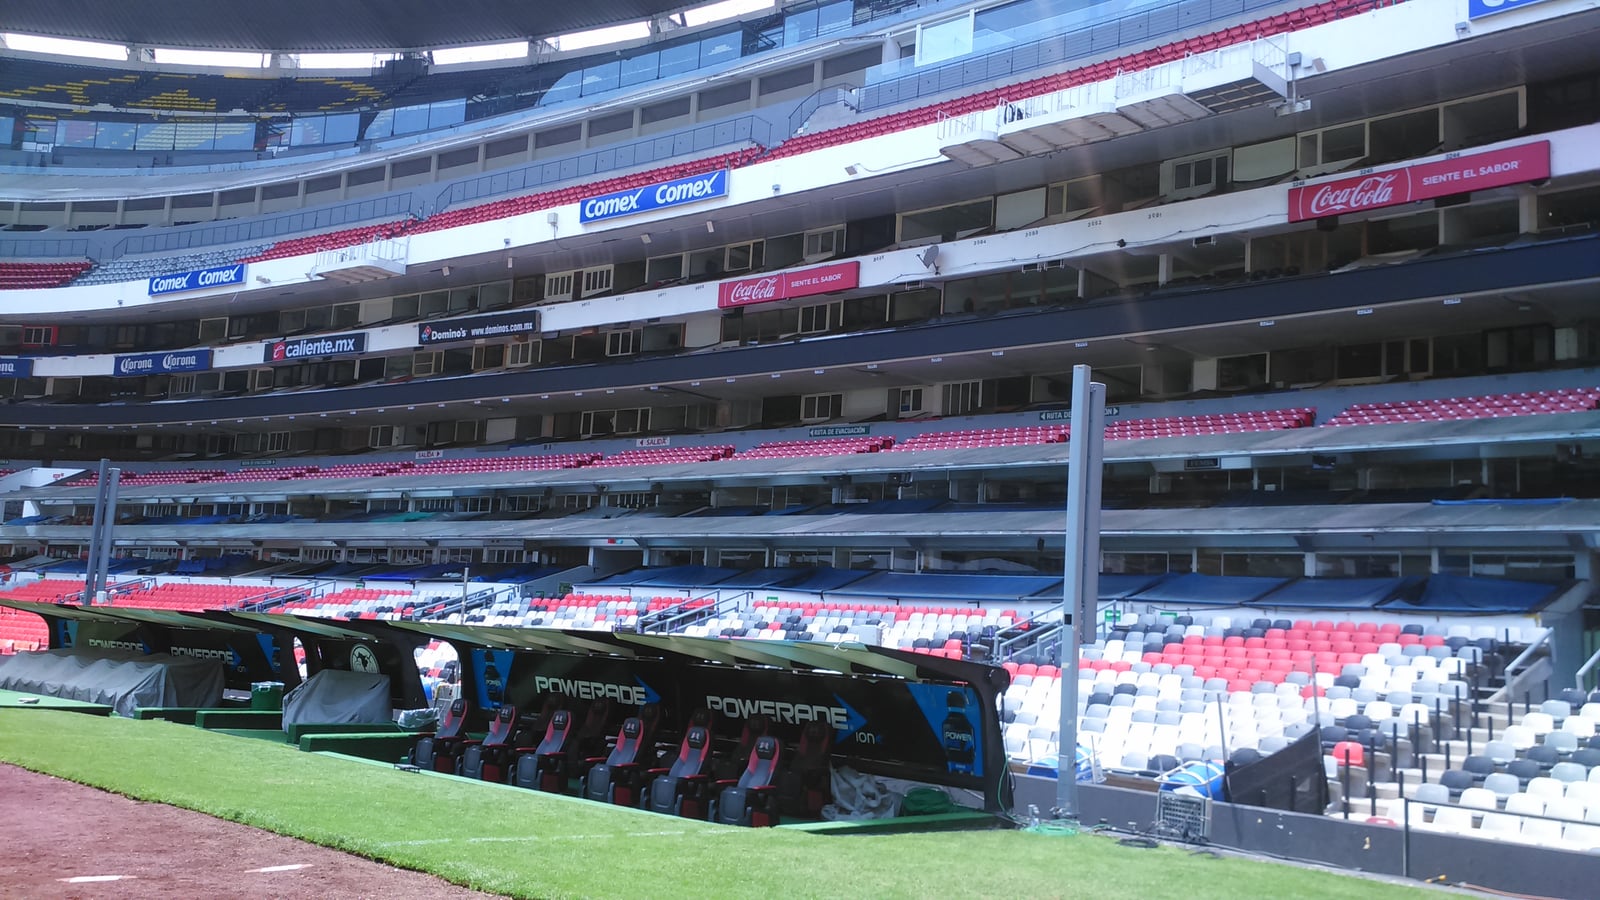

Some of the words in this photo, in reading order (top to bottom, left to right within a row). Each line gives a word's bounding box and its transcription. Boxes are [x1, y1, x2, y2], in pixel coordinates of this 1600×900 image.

[1422, 172, 1461, 186] SIENTE
[1463, 168, 1477, 179] EL
[1479, 161, 1519, 176] SABOR
[585, 188, 644, 218] Comex
[655, 171, 720, 204] Comex
[152, 272, 192, 292] Comex
[198, 265, 240, 285] Comex
[790, 278, 811, 288] SIENTE
[812, 277, 819, 285] EL
[821, 274, 843, 283] SABOR
[431, 328, 467, 340] Domino's
[471, 322, 533, 336] www.dominos.com.mx
[286, 338, 355, 358] caliente.mx
[120, 358, 153, 373] Corona
[163, 354, 197, 370] Corona
[1046, 412, 1063, 420] RUTA
[534, 675, 648, 706] POWERADE
[706, 695, 849, 730] POWERADE
